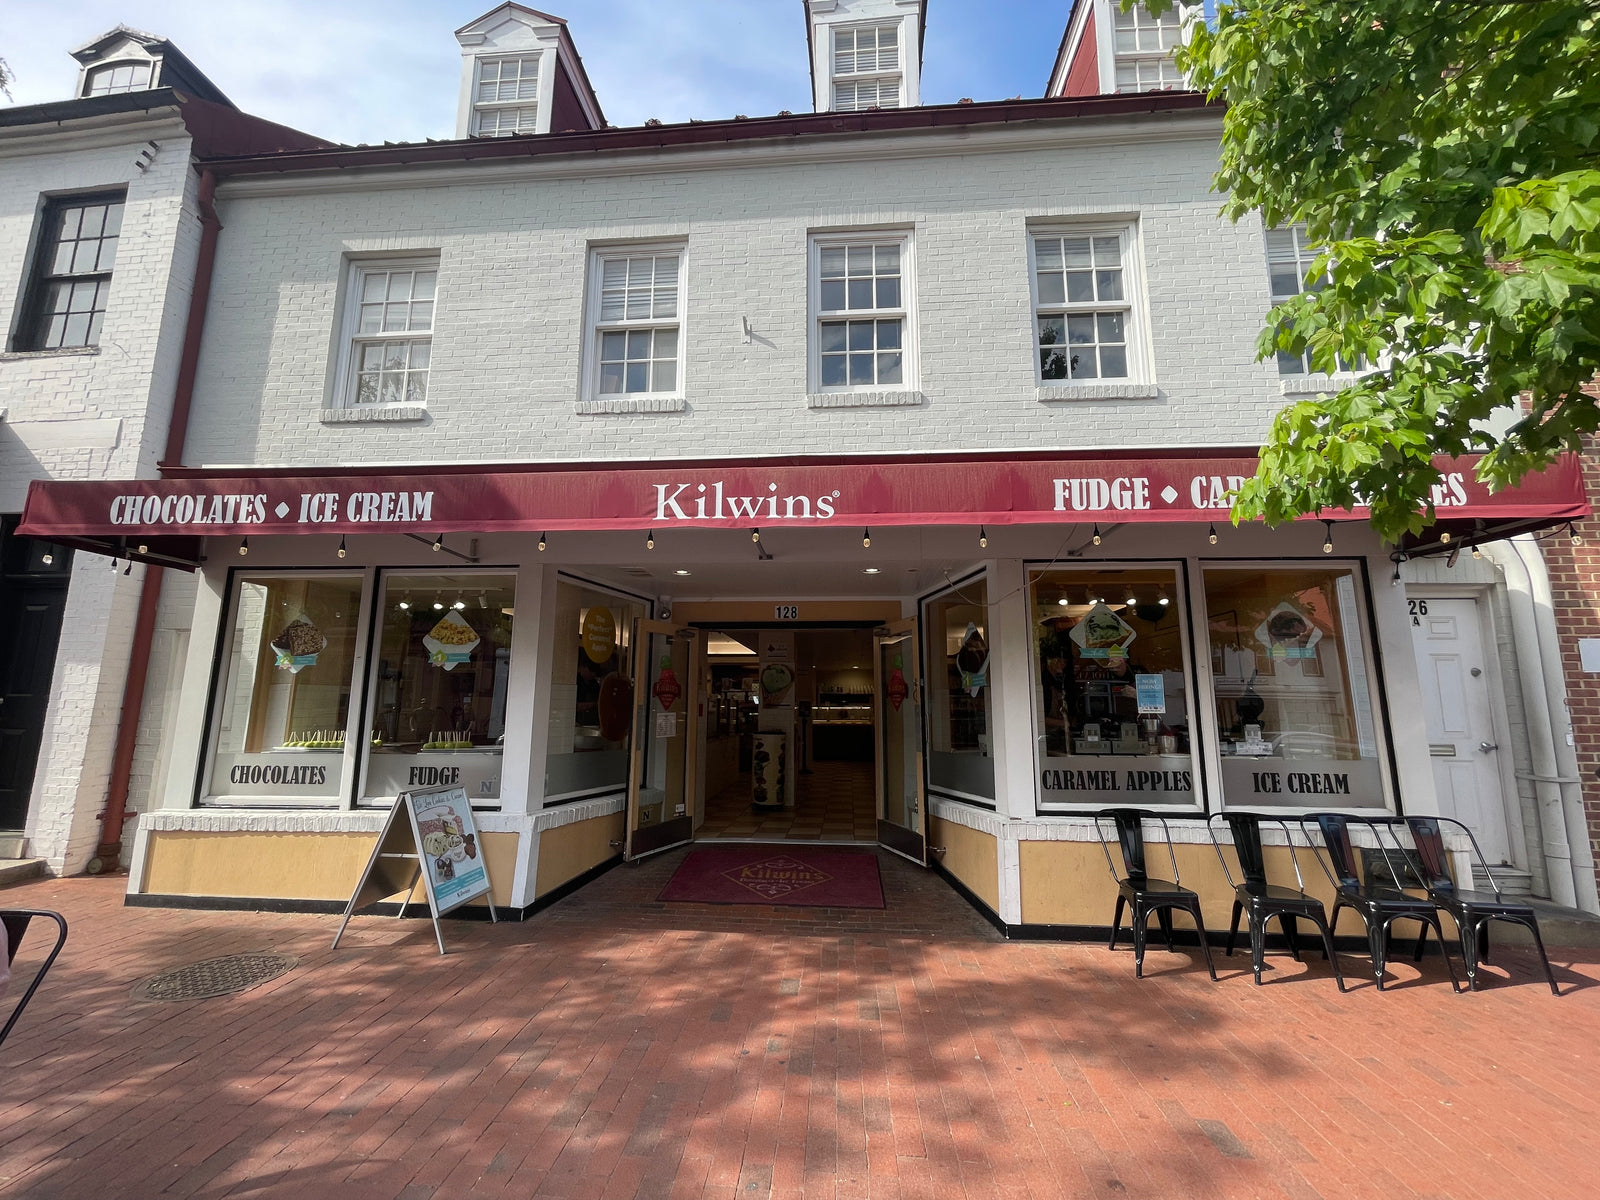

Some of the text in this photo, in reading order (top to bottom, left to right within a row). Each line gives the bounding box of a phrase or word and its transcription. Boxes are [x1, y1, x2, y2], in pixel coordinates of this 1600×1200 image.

[652, 481, 835, 520] Kilwins
[1053, 477, 1150, 512] FUDGE
[109, 491, 434, 525] CHOCOLATES ICE CREAM
[775, 606, 798, 620] 128
[230, 765, 327, 785] CHOCOLATES
[407, 766, 460, 786] FUDGE
[1042, 769, 1192, 792] CARAMEL APPLES
[1253, 772, 1350, 794] ICE CREAM
